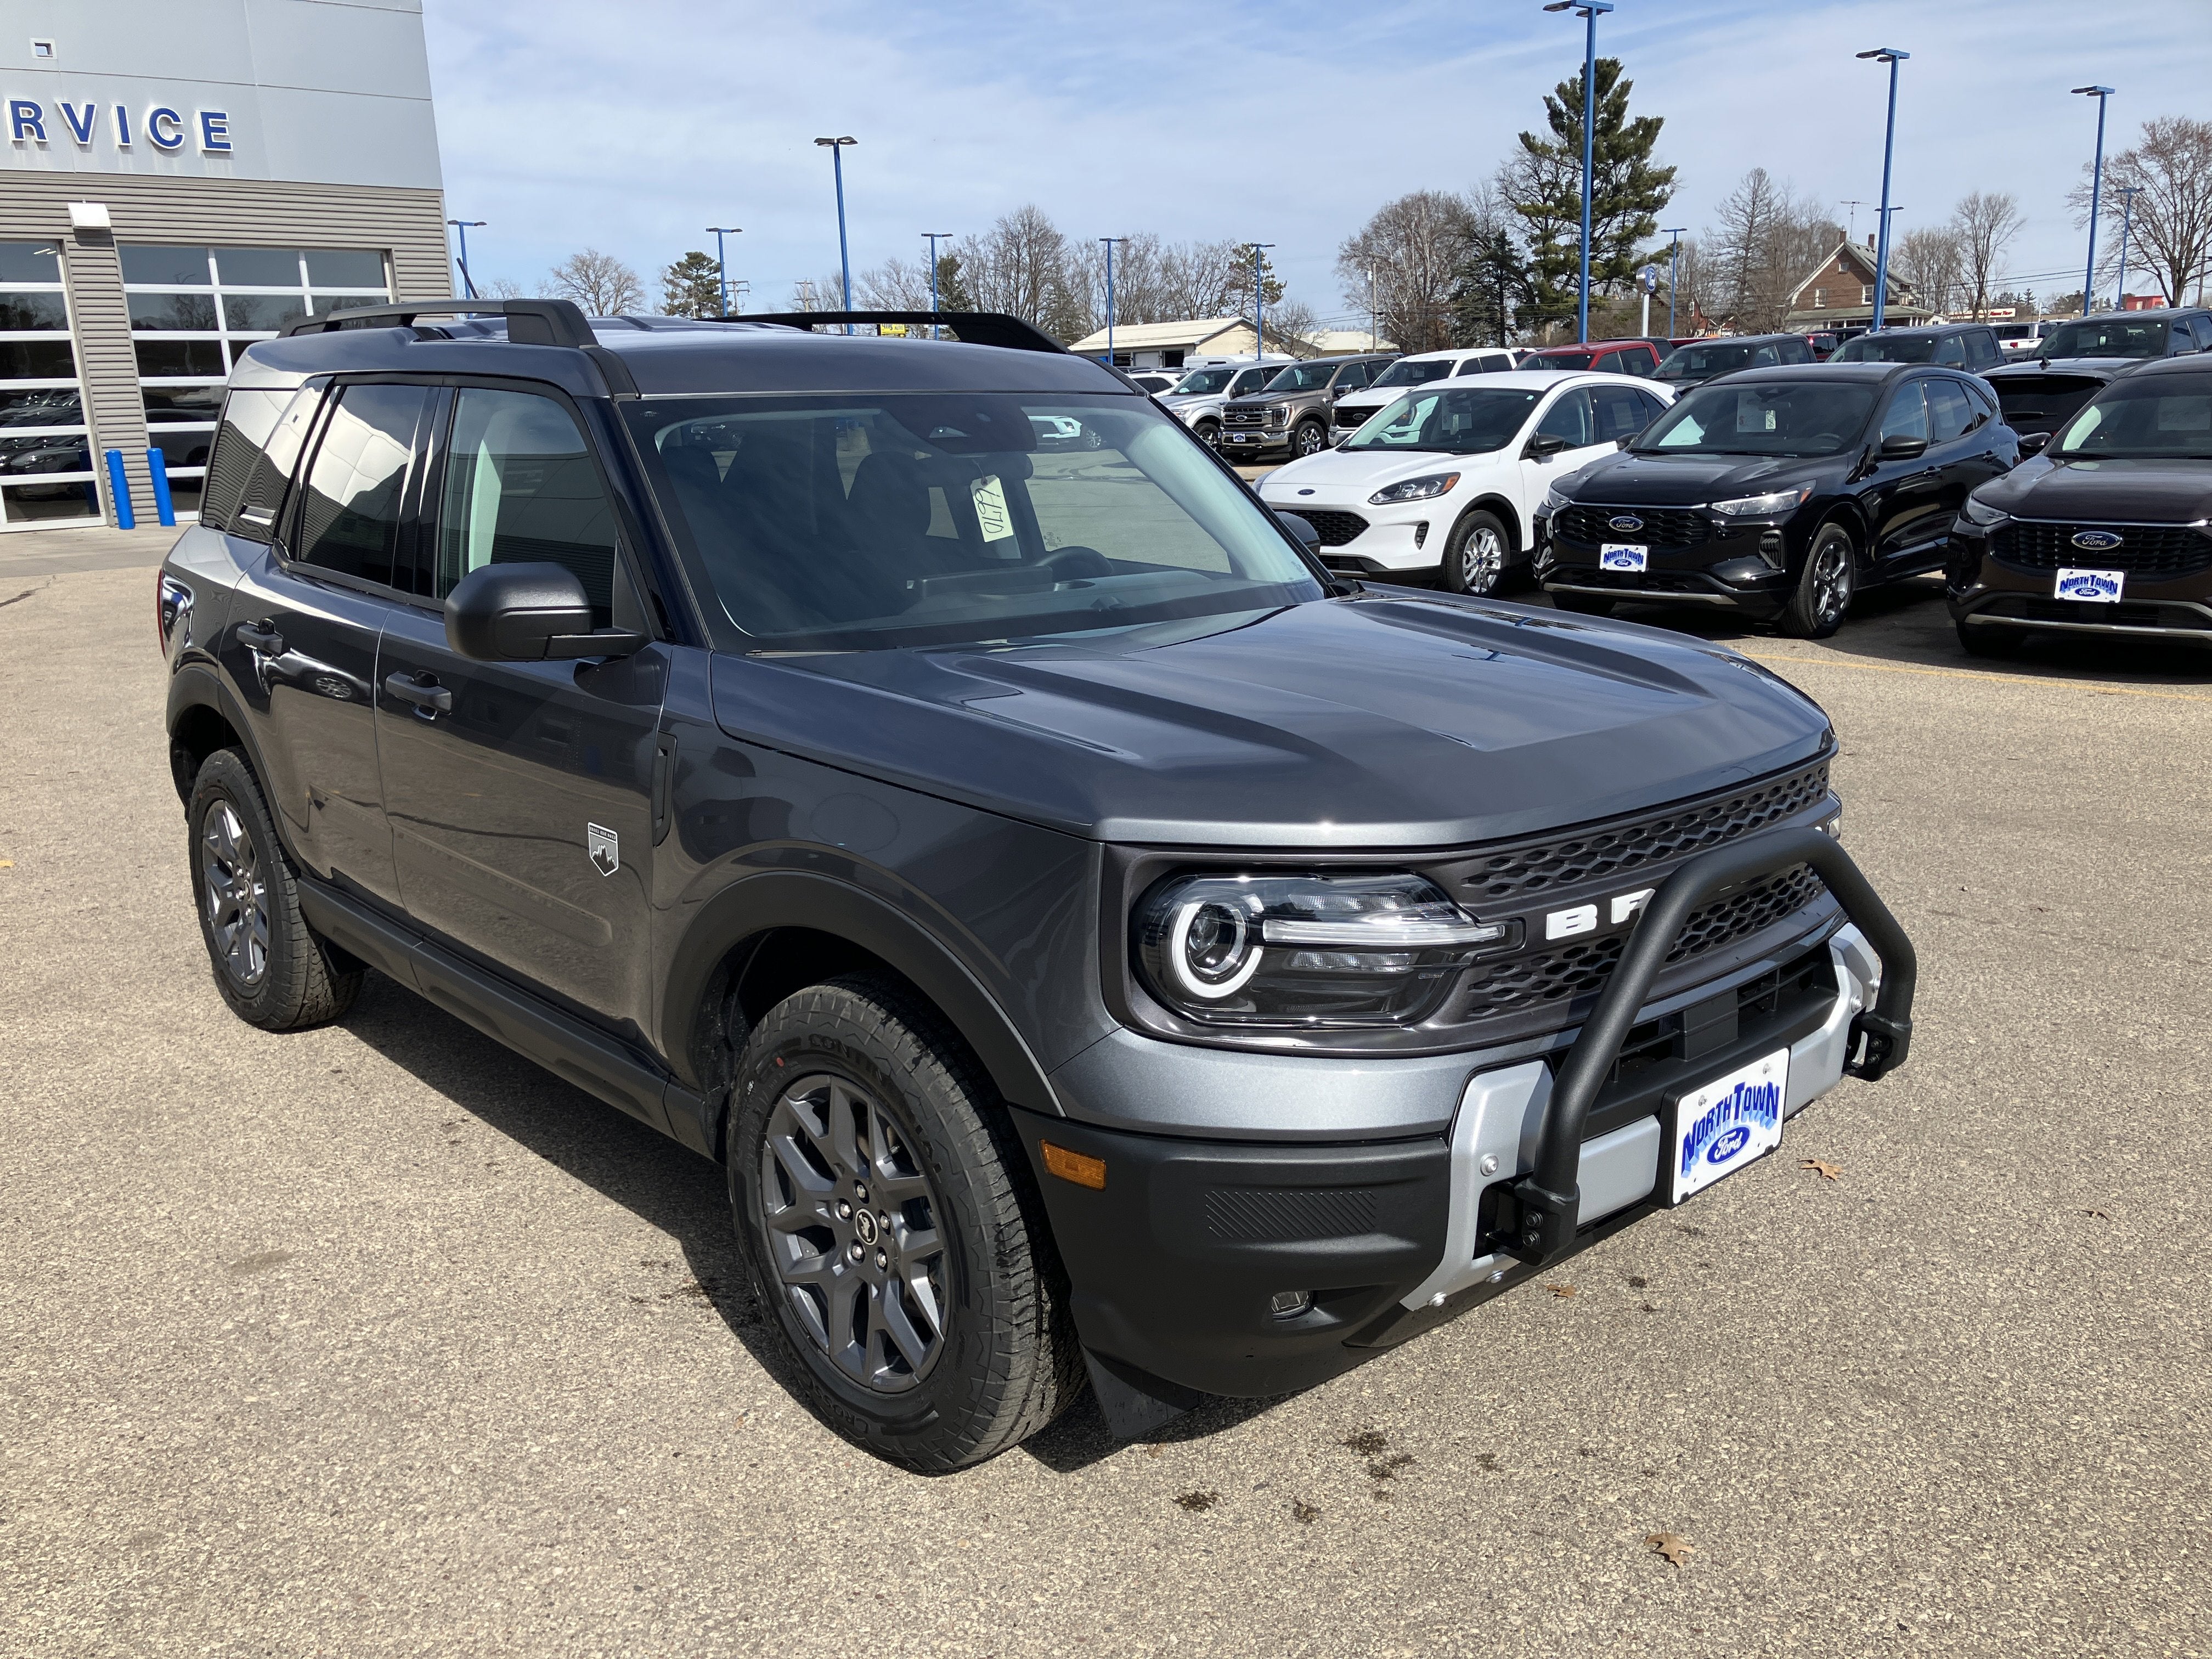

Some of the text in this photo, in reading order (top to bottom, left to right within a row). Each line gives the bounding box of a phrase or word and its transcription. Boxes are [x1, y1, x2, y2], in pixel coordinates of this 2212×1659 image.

[5, 98, 234, 152] RVICE
[975, 488, 1004, 533] 6670
[1616, 519, 1635, 528] Ford
[2082, 534, 2109, 546] Ford
[600, 831, 616, 840] BEND
[1681, 1081, 1780, 1178] NORTH TOWN
[1714, 1130, 1743, 1160] Ford
